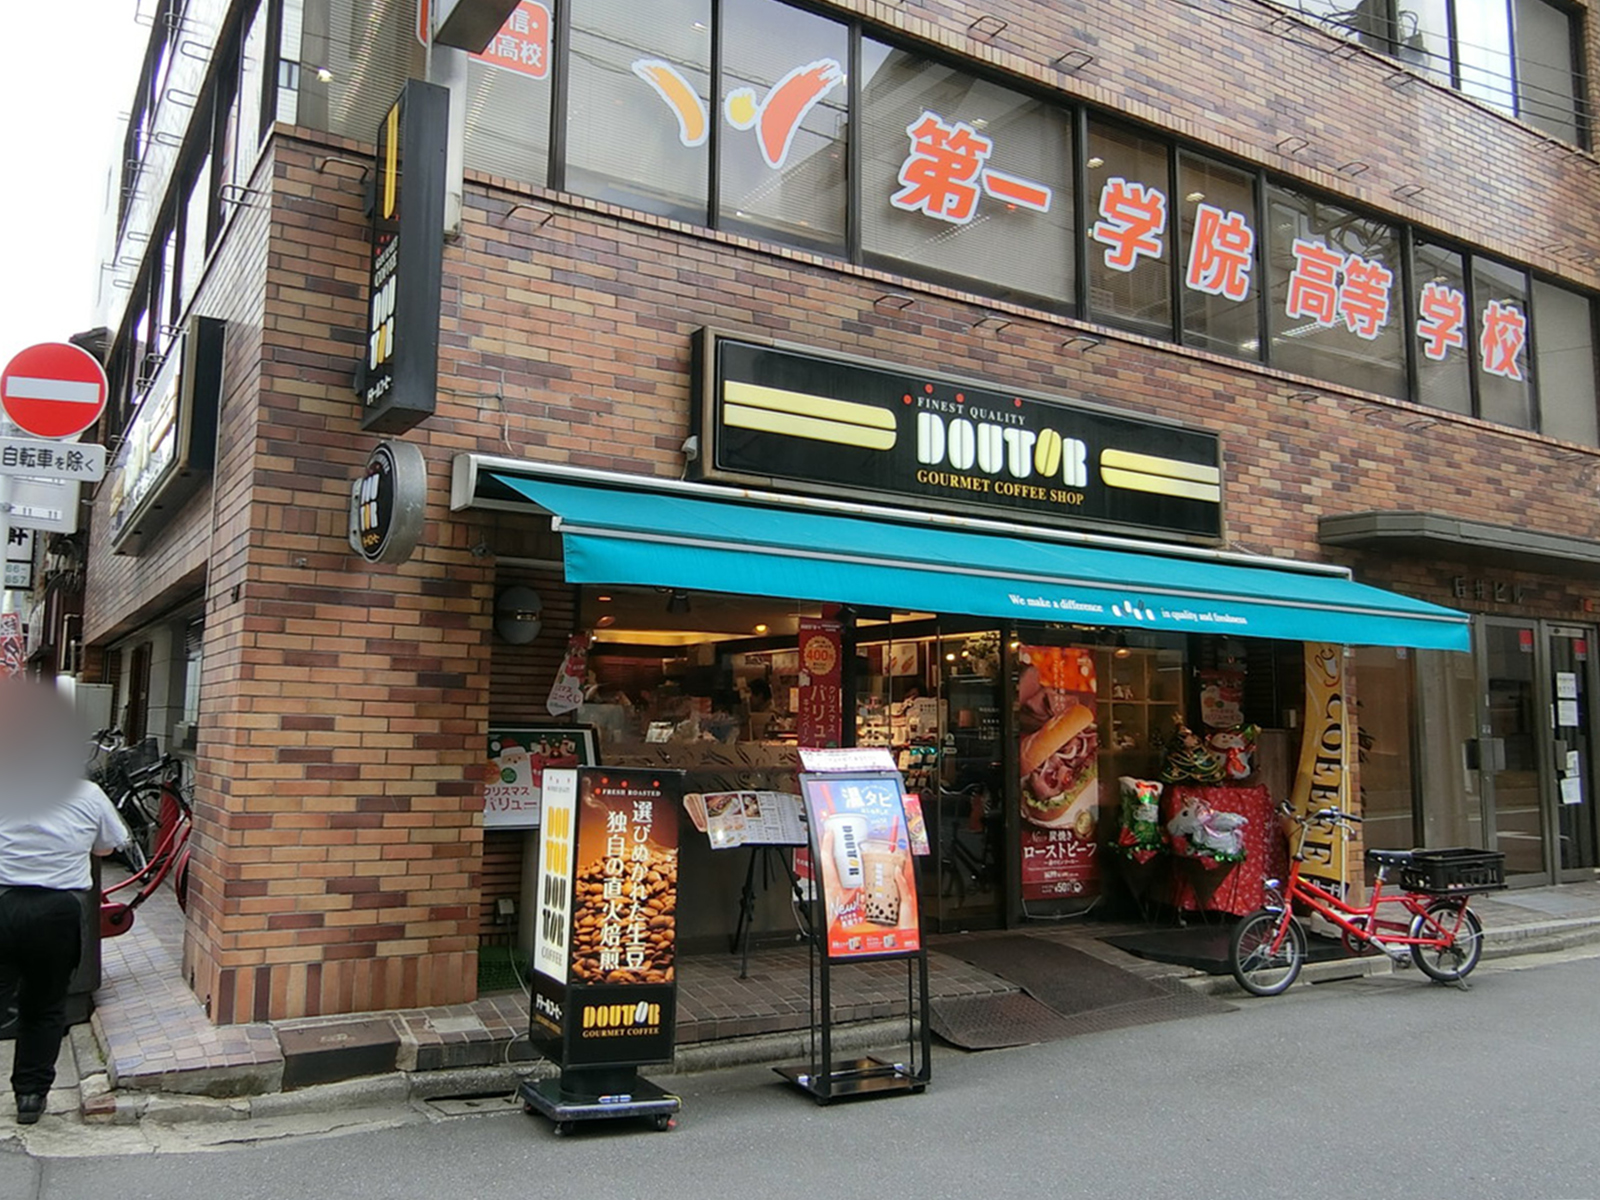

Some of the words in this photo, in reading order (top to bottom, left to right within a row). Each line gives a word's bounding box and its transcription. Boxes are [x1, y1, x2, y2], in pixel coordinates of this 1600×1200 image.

[917, 397, 964, 415] FINEST
[969, 407, 1026, 426] QUALITY
[2, 446, 95, 473] 自転車を除く
[917, 411, 1088, 488] DOUTOR
[917, 470, 990, 493] GOURMET
[994, 481, 1047, 501] COFFEE
[1050, 489, 1085, 506] SHOP
[1008, 594, 1026, 606] We
[1027, 596, 1051, 608] make
[1060, 599, 1104, 613] difference
[1171, 609, 1199, 622] quality
[602, 788, 626, 796] FRESH
[628, 789, 661, 797] ROASTED
[547, 805, 569, 840] DOU
[1023, 841, 1097, 859] ローストビーフ
[543, 874, 566, 911] DOU
[599, 810, 628, 971] 独自の直火焙煎
[624, 800, 653, 971] 選びぬかれた生豆
[541, 946, 563, 967] COFFEE
[583, 1001, 660, 1028] DOUTOR
[582, 1029, 625, 1038] GOURMET
[627, 1027, 660, 1036] COFFEE
